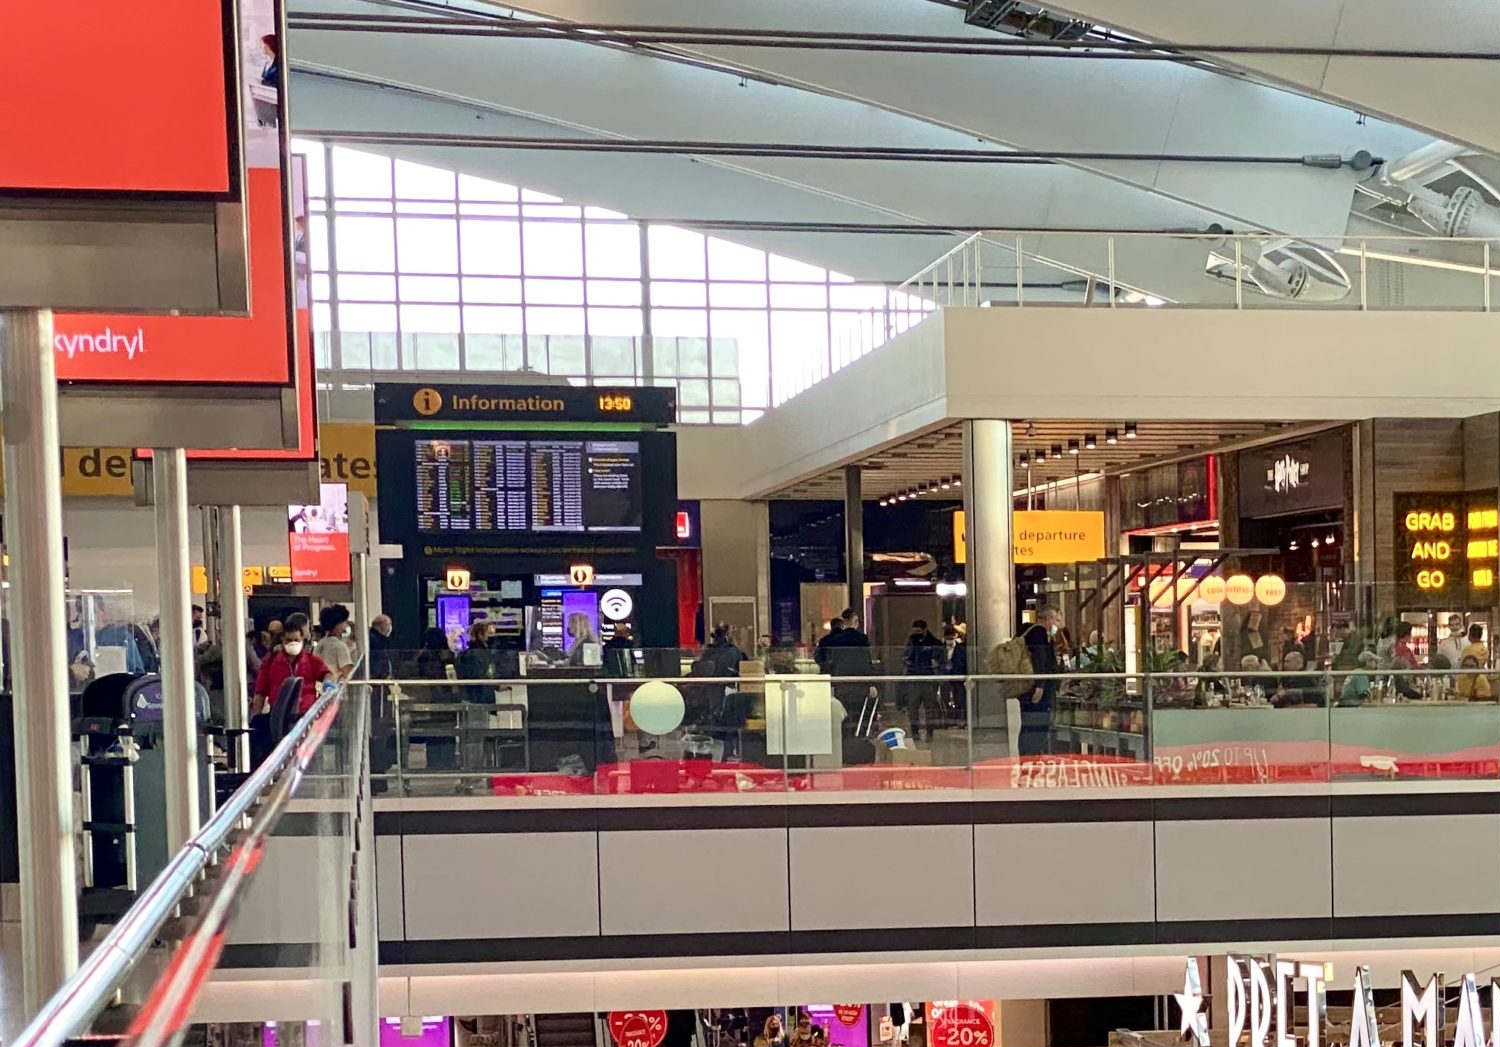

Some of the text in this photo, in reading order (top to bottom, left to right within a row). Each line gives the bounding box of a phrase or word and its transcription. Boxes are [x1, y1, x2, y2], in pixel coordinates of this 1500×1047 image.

[452, 394, 565, 411] Information
[1405, 512, 1456, 532] GRAB
[1019, 530, 1086, 543] departure
[1411, 540, 1450, 560] AND
[1416, 570, 1446, 588] GO
[937, 1027, 989, 1046] -20%
